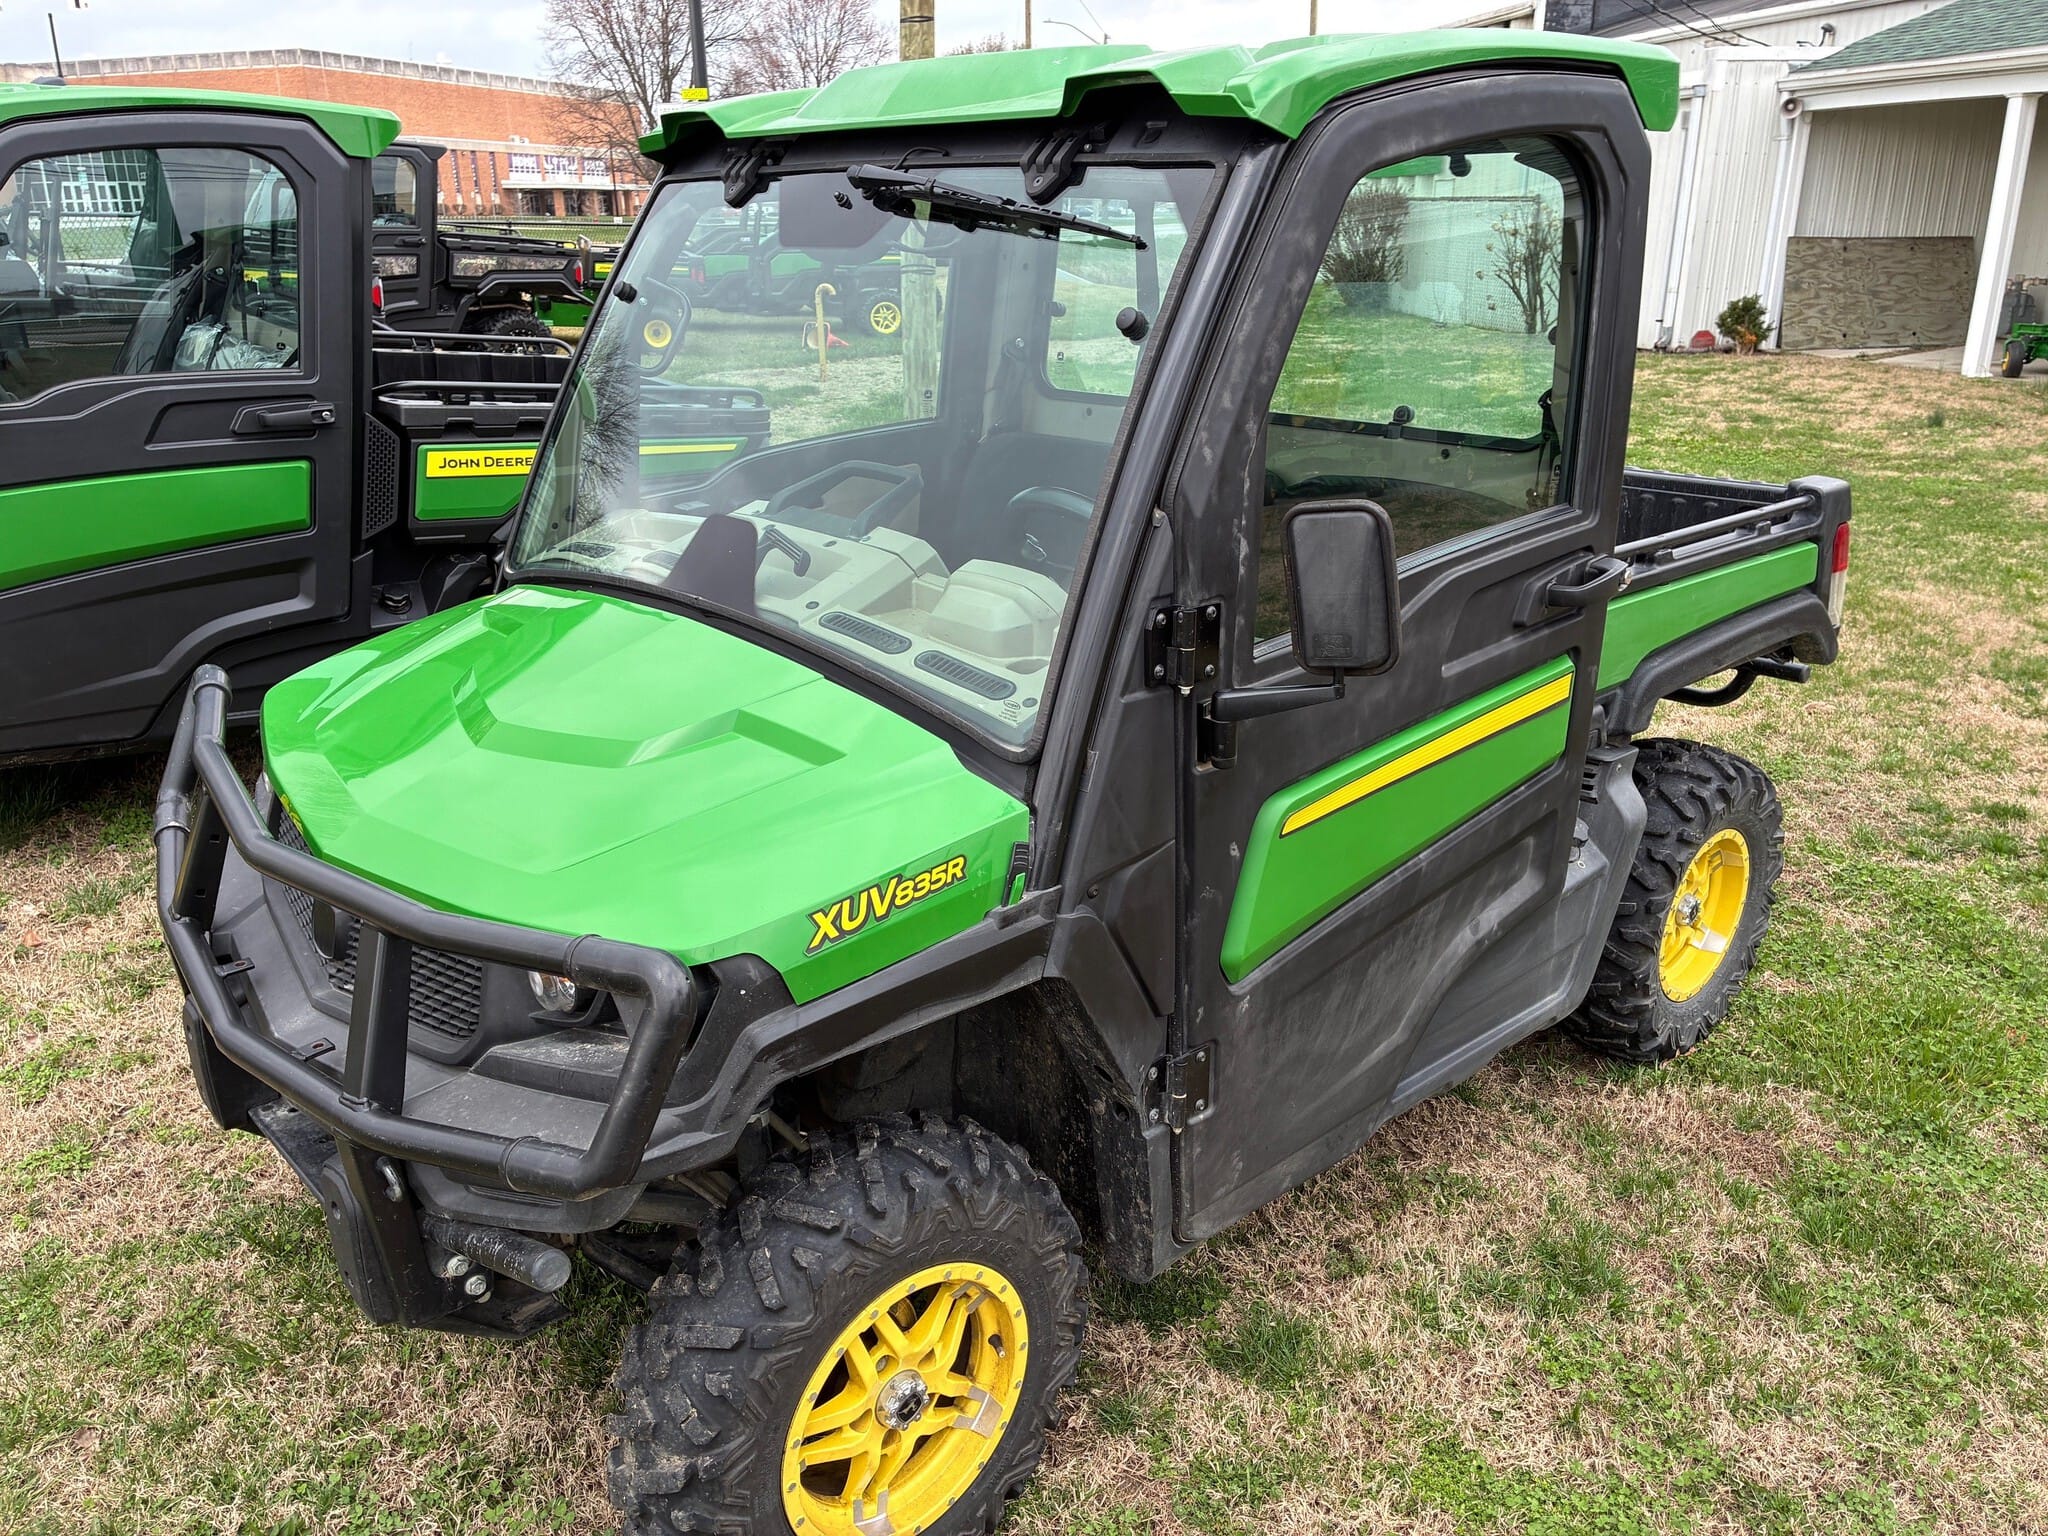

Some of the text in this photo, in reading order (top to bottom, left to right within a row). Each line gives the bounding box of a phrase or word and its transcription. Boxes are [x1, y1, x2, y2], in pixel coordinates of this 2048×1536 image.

[438, 456, 533, 469] JOHN DEERE
[808, 855, 966, 952] XUV835R
